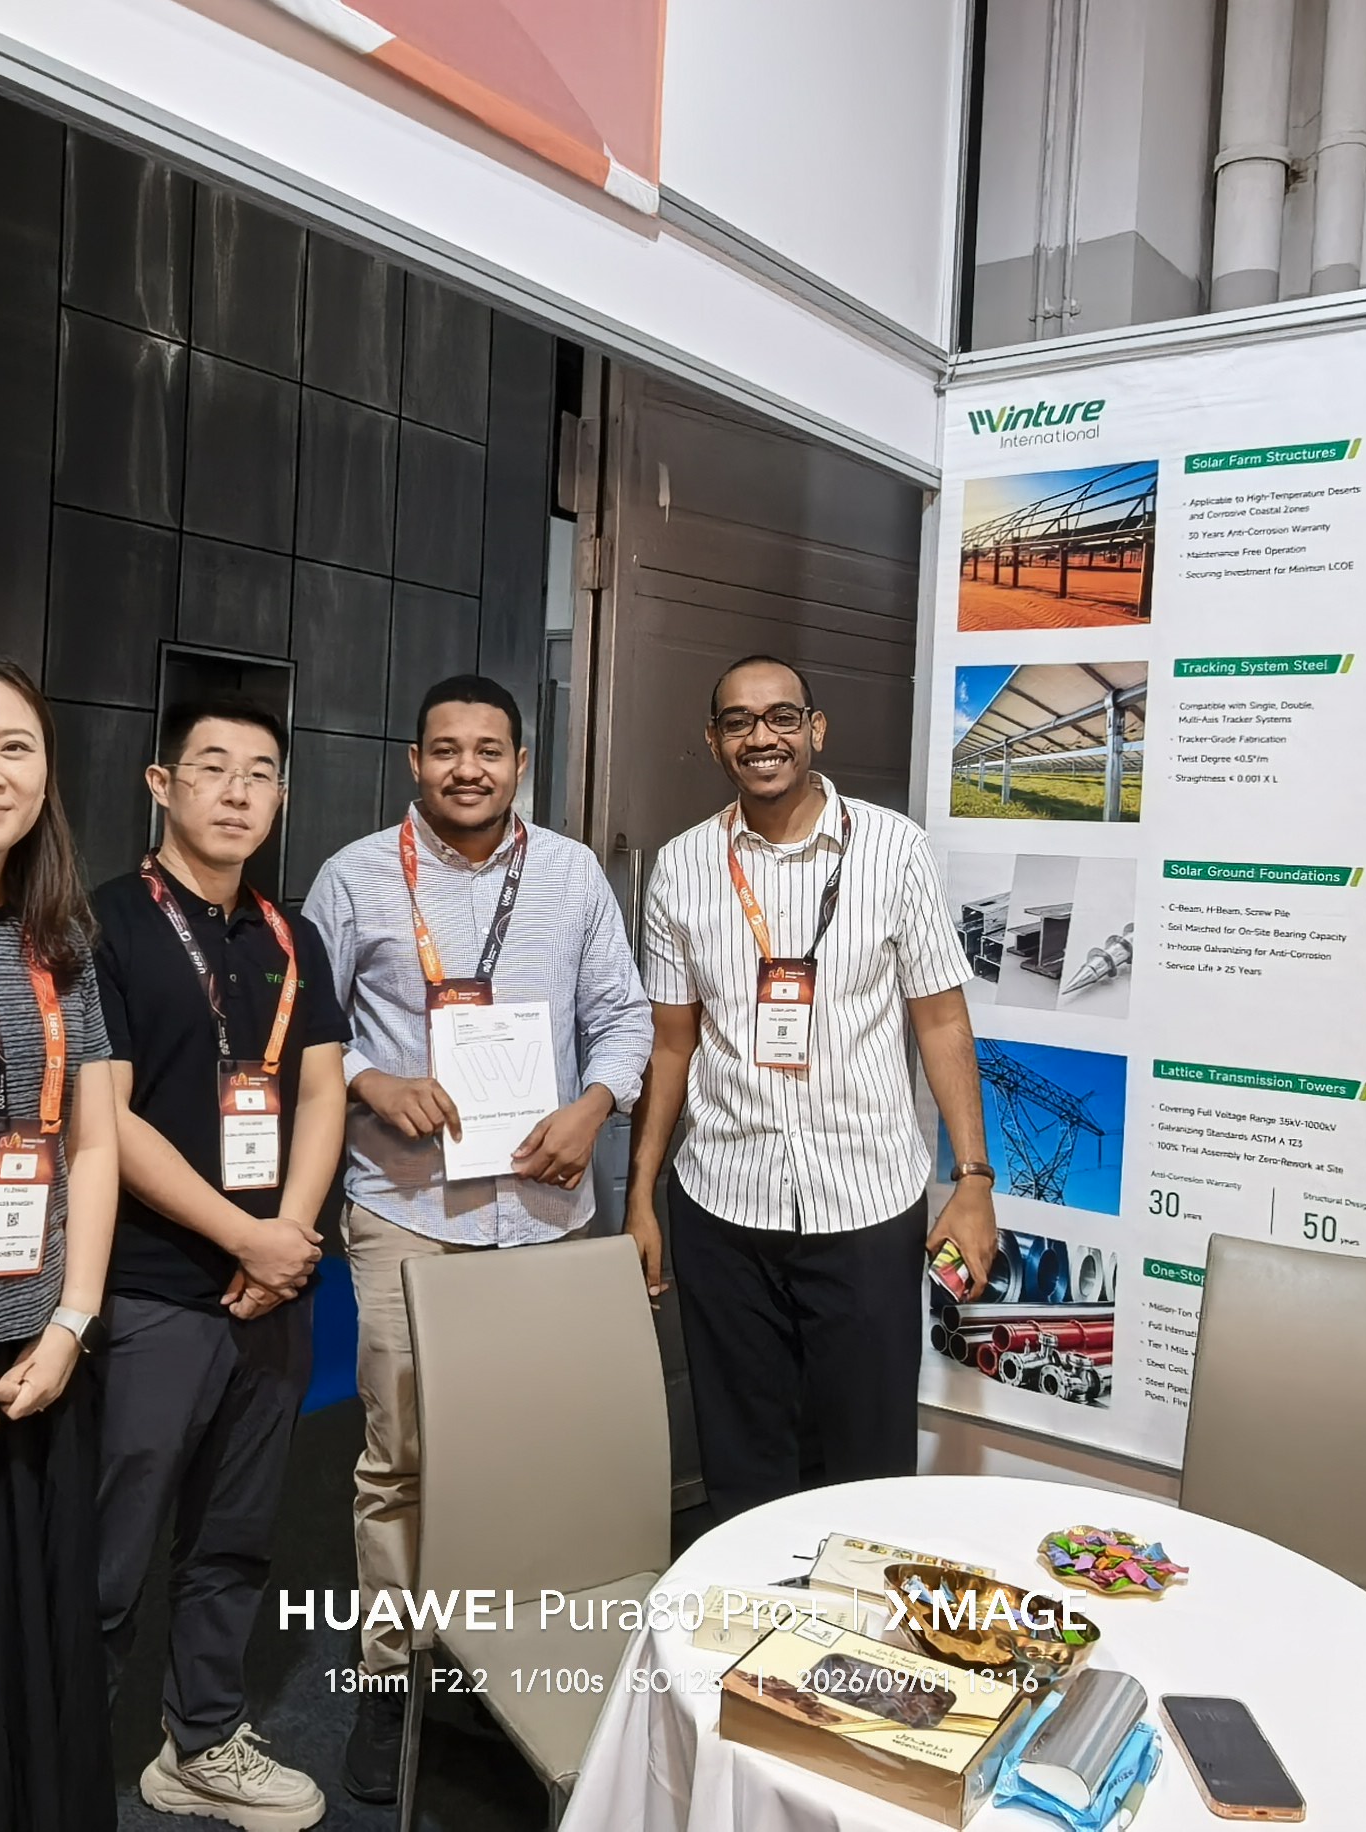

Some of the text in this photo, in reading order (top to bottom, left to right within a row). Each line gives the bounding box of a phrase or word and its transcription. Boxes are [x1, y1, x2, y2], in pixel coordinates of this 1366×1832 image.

[968, 399, 1105, 435] Winture
[1000, 425, 1100, 449] International
[1193, 447, 1336, 469] Solar Farm Structures
[1236, 495, 1244, 503] to
[1249, 506, 1281, 516] Coastal
[1202, 523, 1331, 539] Years Warranty
[1242, 546, 1306, 556] Free Operation
[1328, 561, 1354, 571] LCOE
[1182, 659, 1327, 675] Tracking System Steel
[1228, 702, 1246, 710] with
[1222, 715, 1292, 724] Tracker Systems
[1178, 735, 1287, 743] Tracker-Grade Fabrication
[1201, 755, 1231, 764] Degree
[1176, 774, 1226, 784] Straightness
[1171, 865, 1340, 882] Solar Ground Foundations
[1168, 923, 1347, 942] Soil for Bearing Capacity
[1239, 966, 1262, 975] Years
[1161, 1064, 1346, 1094] Lattice Transmission Towers
[1197, 1107, 1276, 1125] Full Range
[1148, 1190, 1179, 1217] 30
[1303, 1212, 1336, 1242] 50
